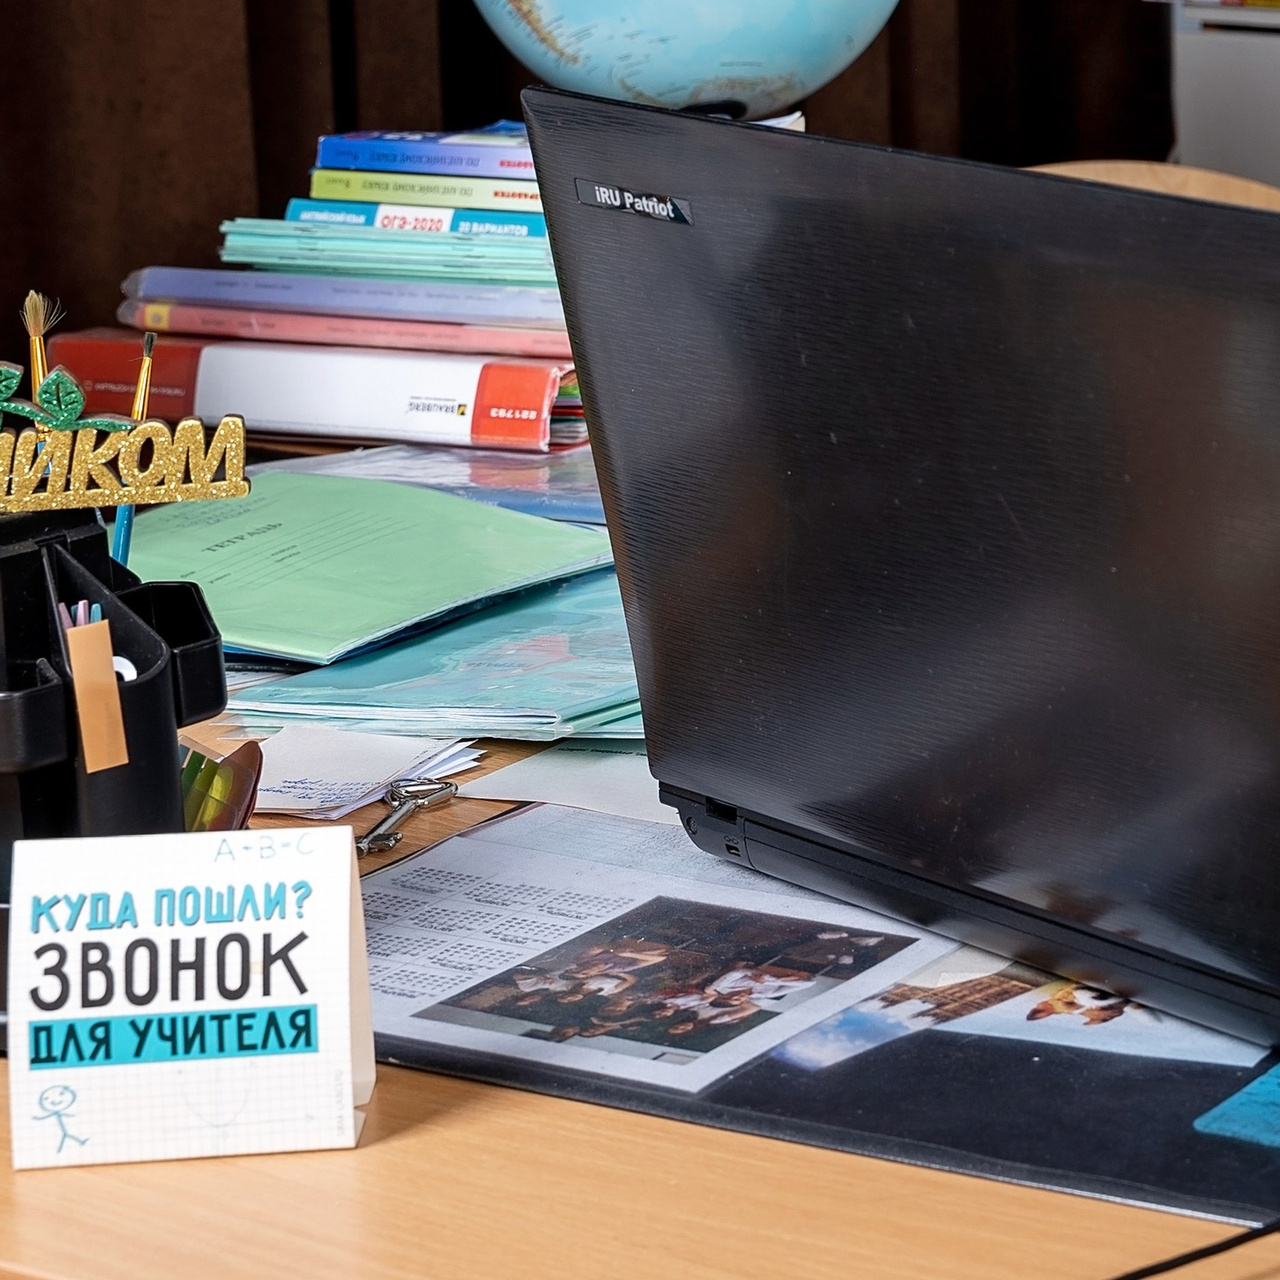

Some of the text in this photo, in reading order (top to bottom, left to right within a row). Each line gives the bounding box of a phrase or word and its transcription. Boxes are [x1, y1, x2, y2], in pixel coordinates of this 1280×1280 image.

[594, 185, 675, 218] iRU Patriot
[407, 401, 457, 415] BRAUBERG
[201, 522, 283, 552] ТЕТРАДЬ
[29, 892, 140, 934] КУДА
[154, 879, 314, 927] ПОШЛИ?
[29, 930, 310, 1012] ЗВОНОК
[30, 1007, 313, 1066] ДЛЯ УЧИТЕЛЯ
